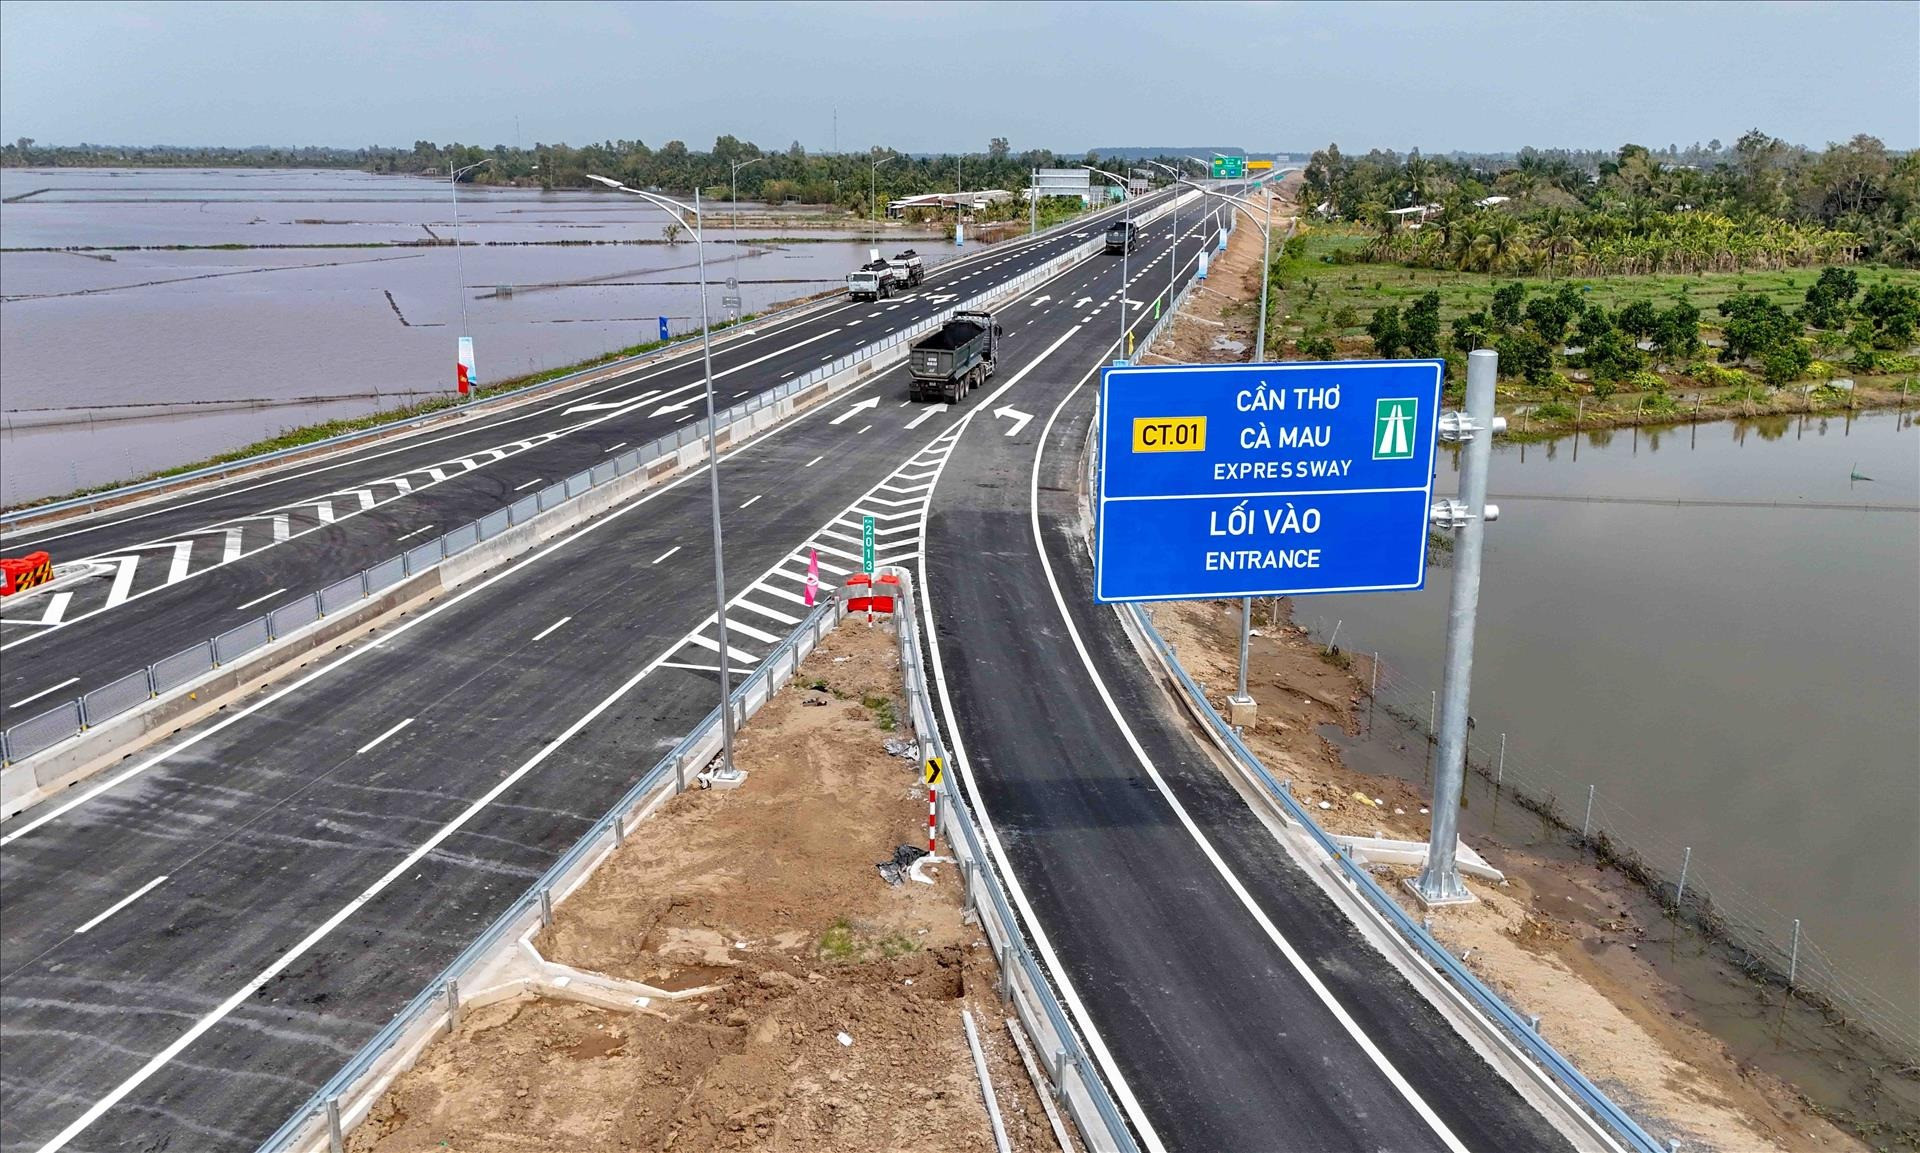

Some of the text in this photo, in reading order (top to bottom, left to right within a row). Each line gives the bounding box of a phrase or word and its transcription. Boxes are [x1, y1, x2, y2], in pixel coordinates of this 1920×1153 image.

[1236, 380, 1341, 412] CẦN THƠ
[1142, 423, 1198, 446] CT.01
[1240, 423, 1331, 449] CÀ MAU
[1214, 459, 1353, 481] EXPRESSWAY
[1210, 499, 1321, 537] LỐI VÀO
[1205, 549, 1321, 571] ENTRANCE
